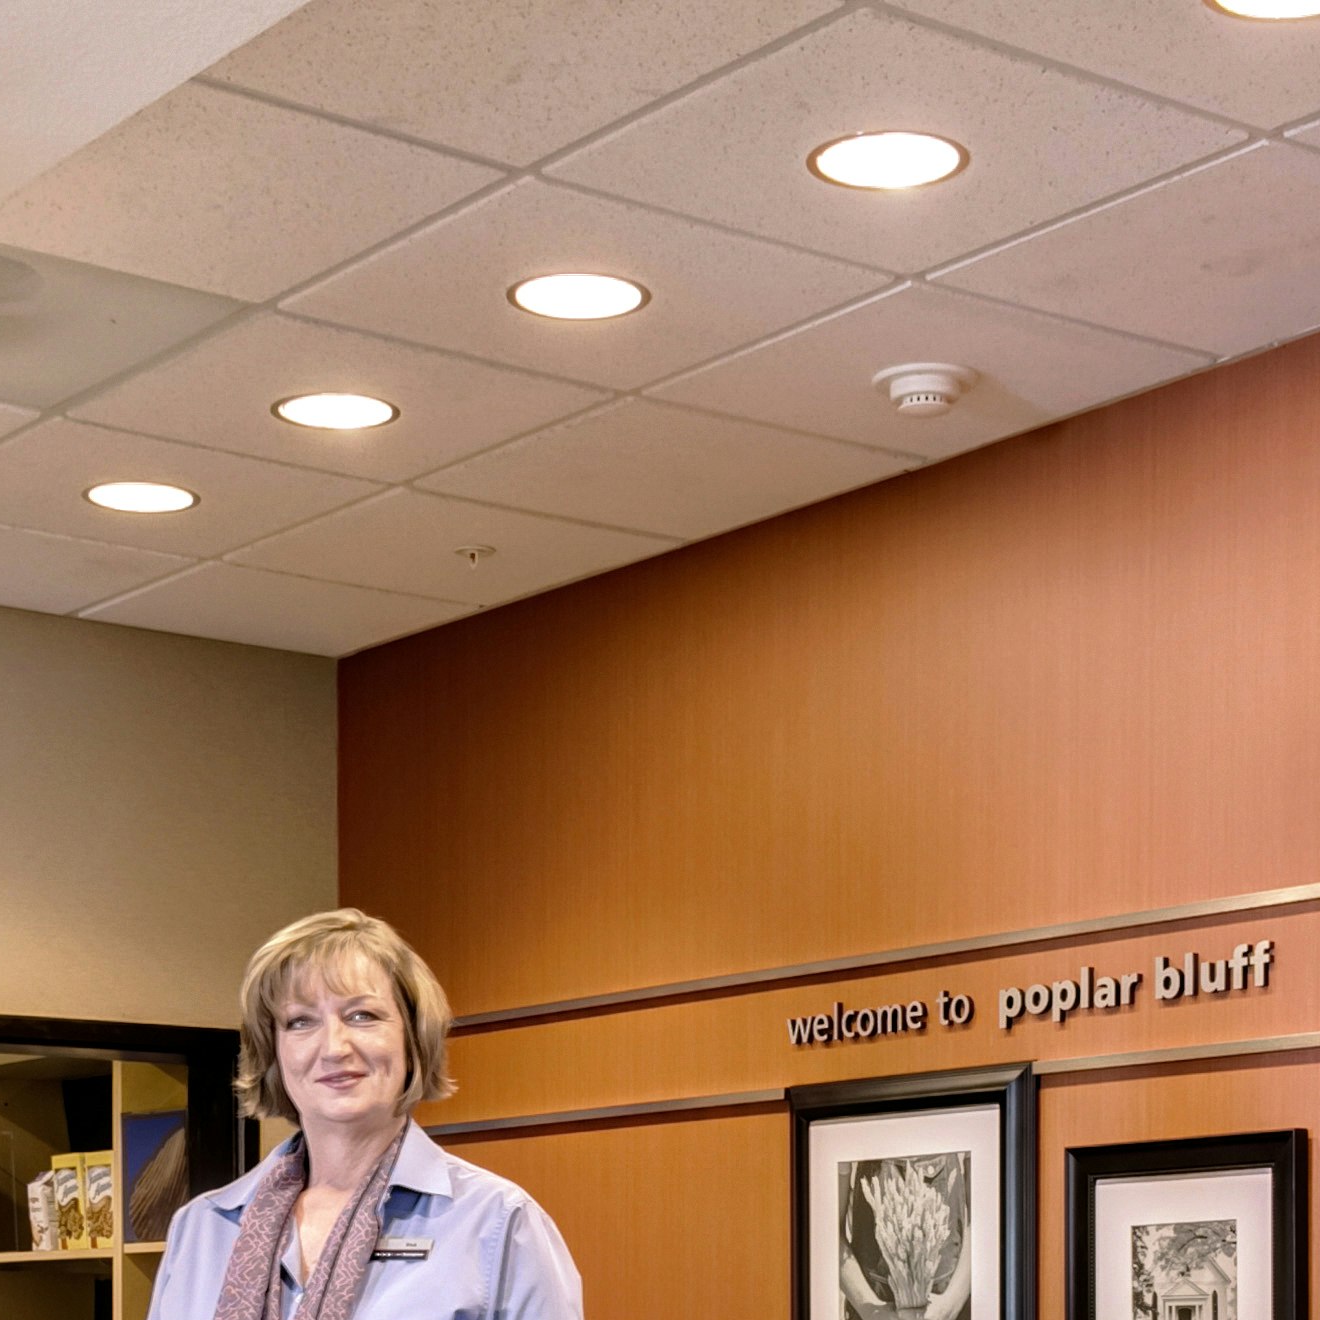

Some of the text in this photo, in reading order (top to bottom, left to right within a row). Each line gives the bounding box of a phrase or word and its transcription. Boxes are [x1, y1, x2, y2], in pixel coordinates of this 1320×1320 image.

[786, 940, 1276, 1045] welcome to poplar bluff
